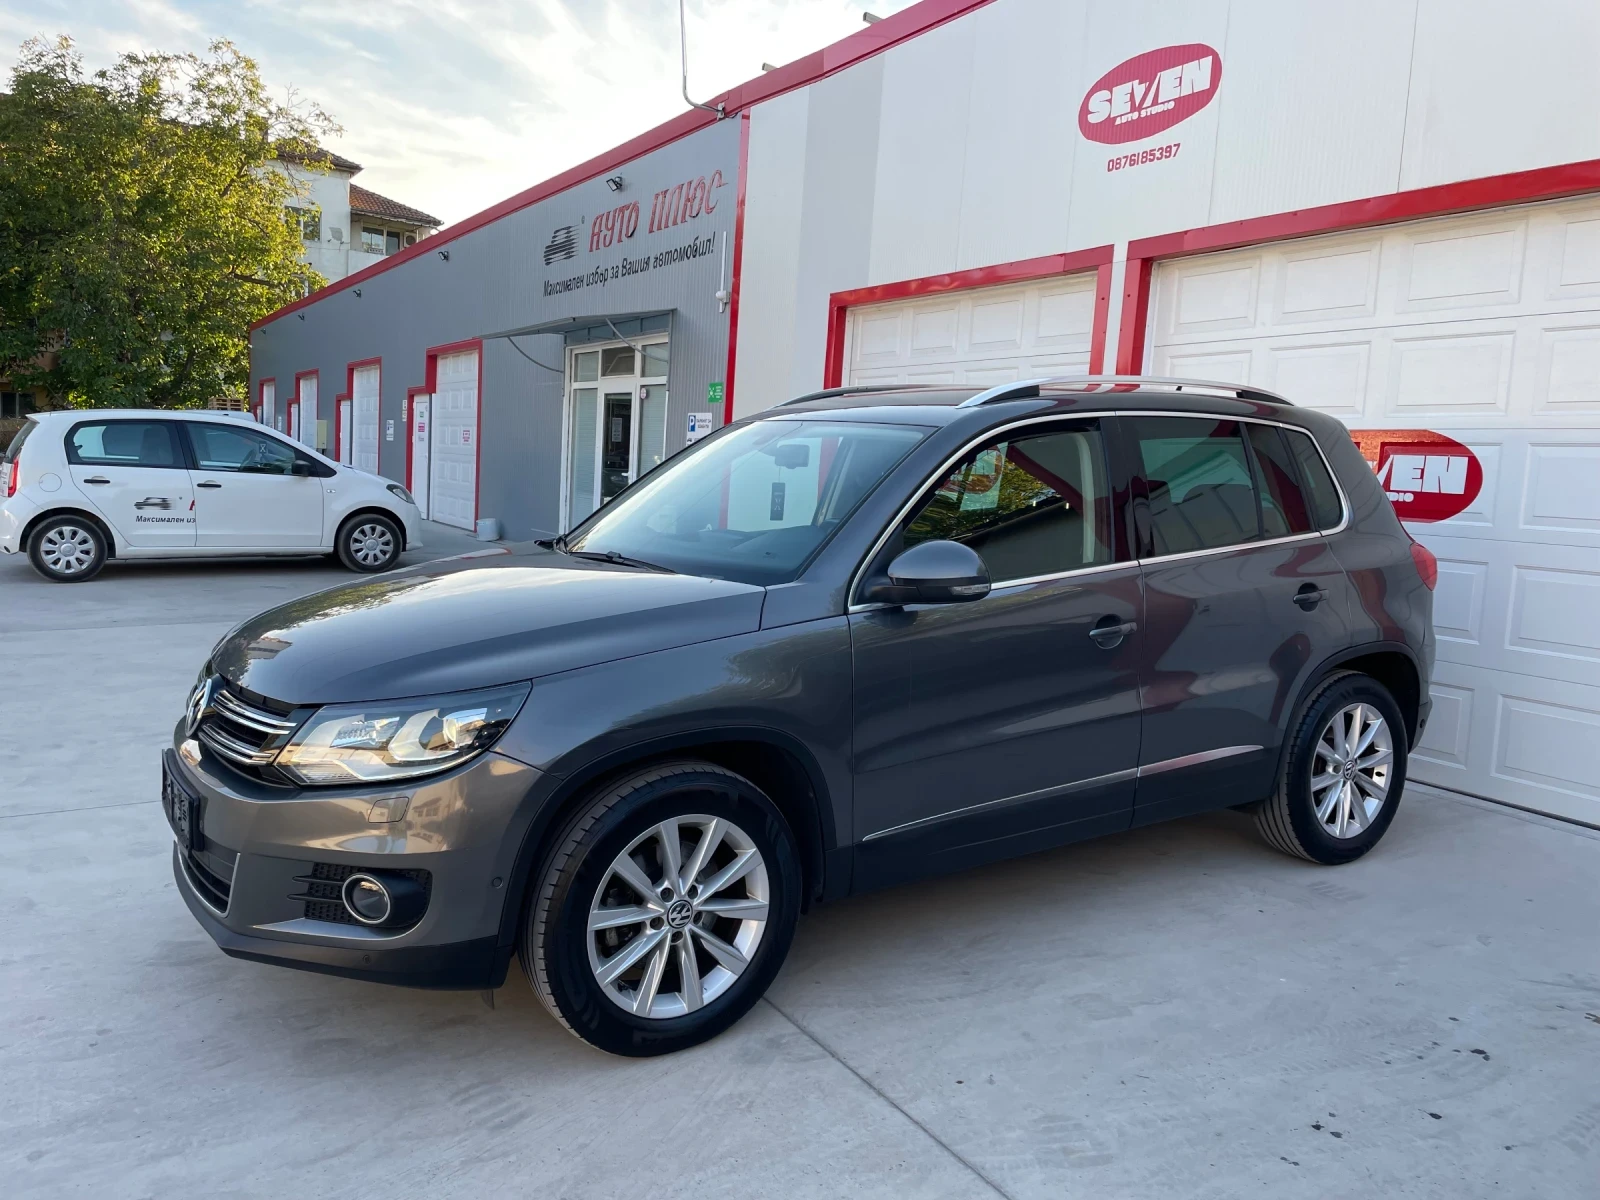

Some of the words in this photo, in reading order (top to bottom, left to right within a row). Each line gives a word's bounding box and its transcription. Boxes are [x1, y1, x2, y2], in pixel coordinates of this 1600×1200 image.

[1088, 56, 1212, 124] SEVEN
[1115, 112, 1139, 126] AUTO
[1140, 101, 1175, 117] STUDIO
[1107, 143, 1181, 172] 0876185397
[589, 201, 640, 252] АУТО
[648, 169, 728, 233] ПЛЮС
[543, 275, 585, 297] Максимален
[610, 265, 619, 280] за
[621, 256, 651, 277] Вашия
[652, 231, 716, 269] автомобил!
[135, 515, 185, 523] Максимален
